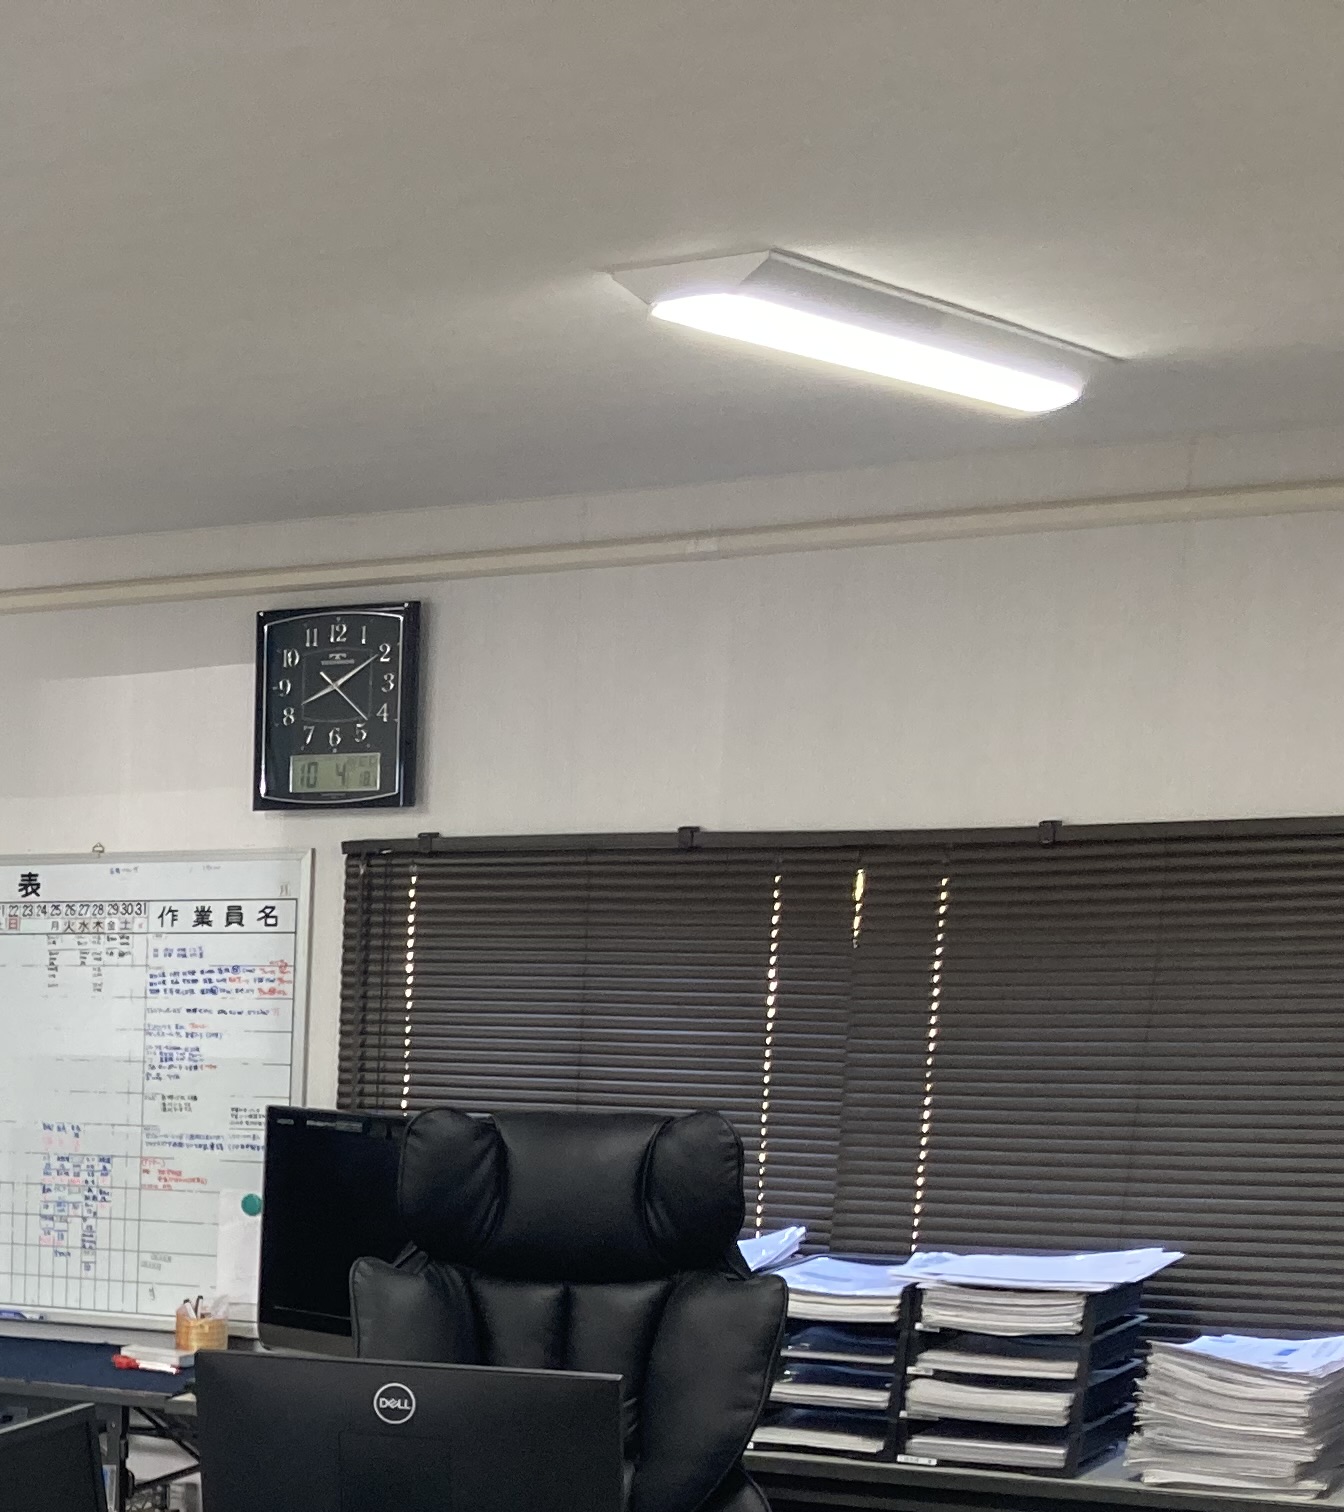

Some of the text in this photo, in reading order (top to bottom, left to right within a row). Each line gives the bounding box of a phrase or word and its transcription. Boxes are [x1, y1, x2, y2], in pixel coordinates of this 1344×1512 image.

[305, 628, 318, 647] 11
[330, 624, 347, 643] 12
[362, 626, 367, 645] 1
[282, 650, 300, 668] 10
[379, 643, 391, 662] 2
[278, 679, 291, 697] 9
[381, 673, 395, 693] 3
[282, 707, 295, 726] 8
[376, 703, 389, 722] 4
[304, 726, 315, 745] 7
[329, 728, 342, 747] 6
[354, 724, 367, 743] 5
[336, 762, 346, 786] 4
[8, 904, 18, 917] 22
[22, 904, 33, 917] 23
[50, 904, 62, 917] 25
[64, 904, 76, 917] 26
[78, 903, 90, 916] 27
[92, 903, 104, 916] 28
[106, 903, 119, 916] 29
[120, 903, 133, 916] 30
[134, 903, 147, 916] 31
[158, 905, 279, 928] 作業員名
[8, 918, 18, 930] 日
[379, 1397, 411, 1410] DELL
